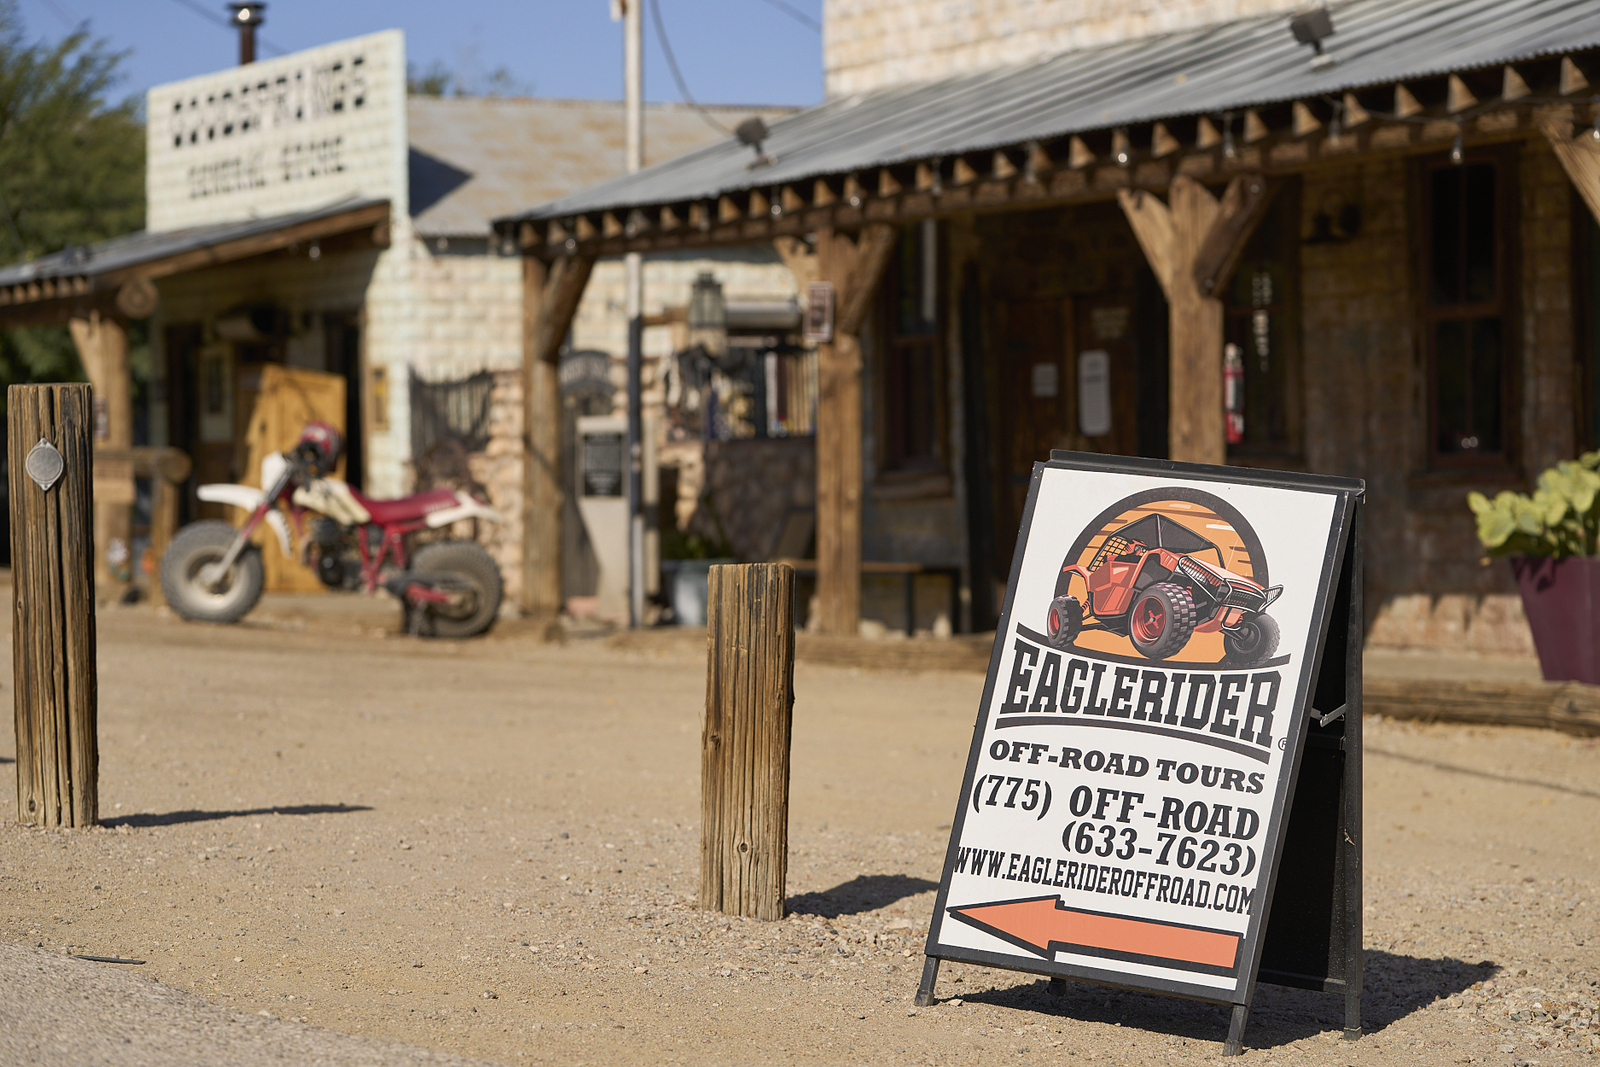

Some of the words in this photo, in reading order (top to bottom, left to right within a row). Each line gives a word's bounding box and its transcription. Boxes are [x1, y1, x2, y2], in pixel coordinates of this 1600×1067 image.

[1000, 638, 1282, 749] EAGLERIDER
[990, 740, 1149, 778] OFF-ROAD
[1156, 759, 1265, 795] TOURS
[973, 774, 1052, 821] (775)
[1069, 785, 1260, 841] OFF-ROAD
[953, 846, 1256, 916] WWW.EAGLERIDEROFFROAD.COM
[1062, 821, 1257, 878] (633-7623)
